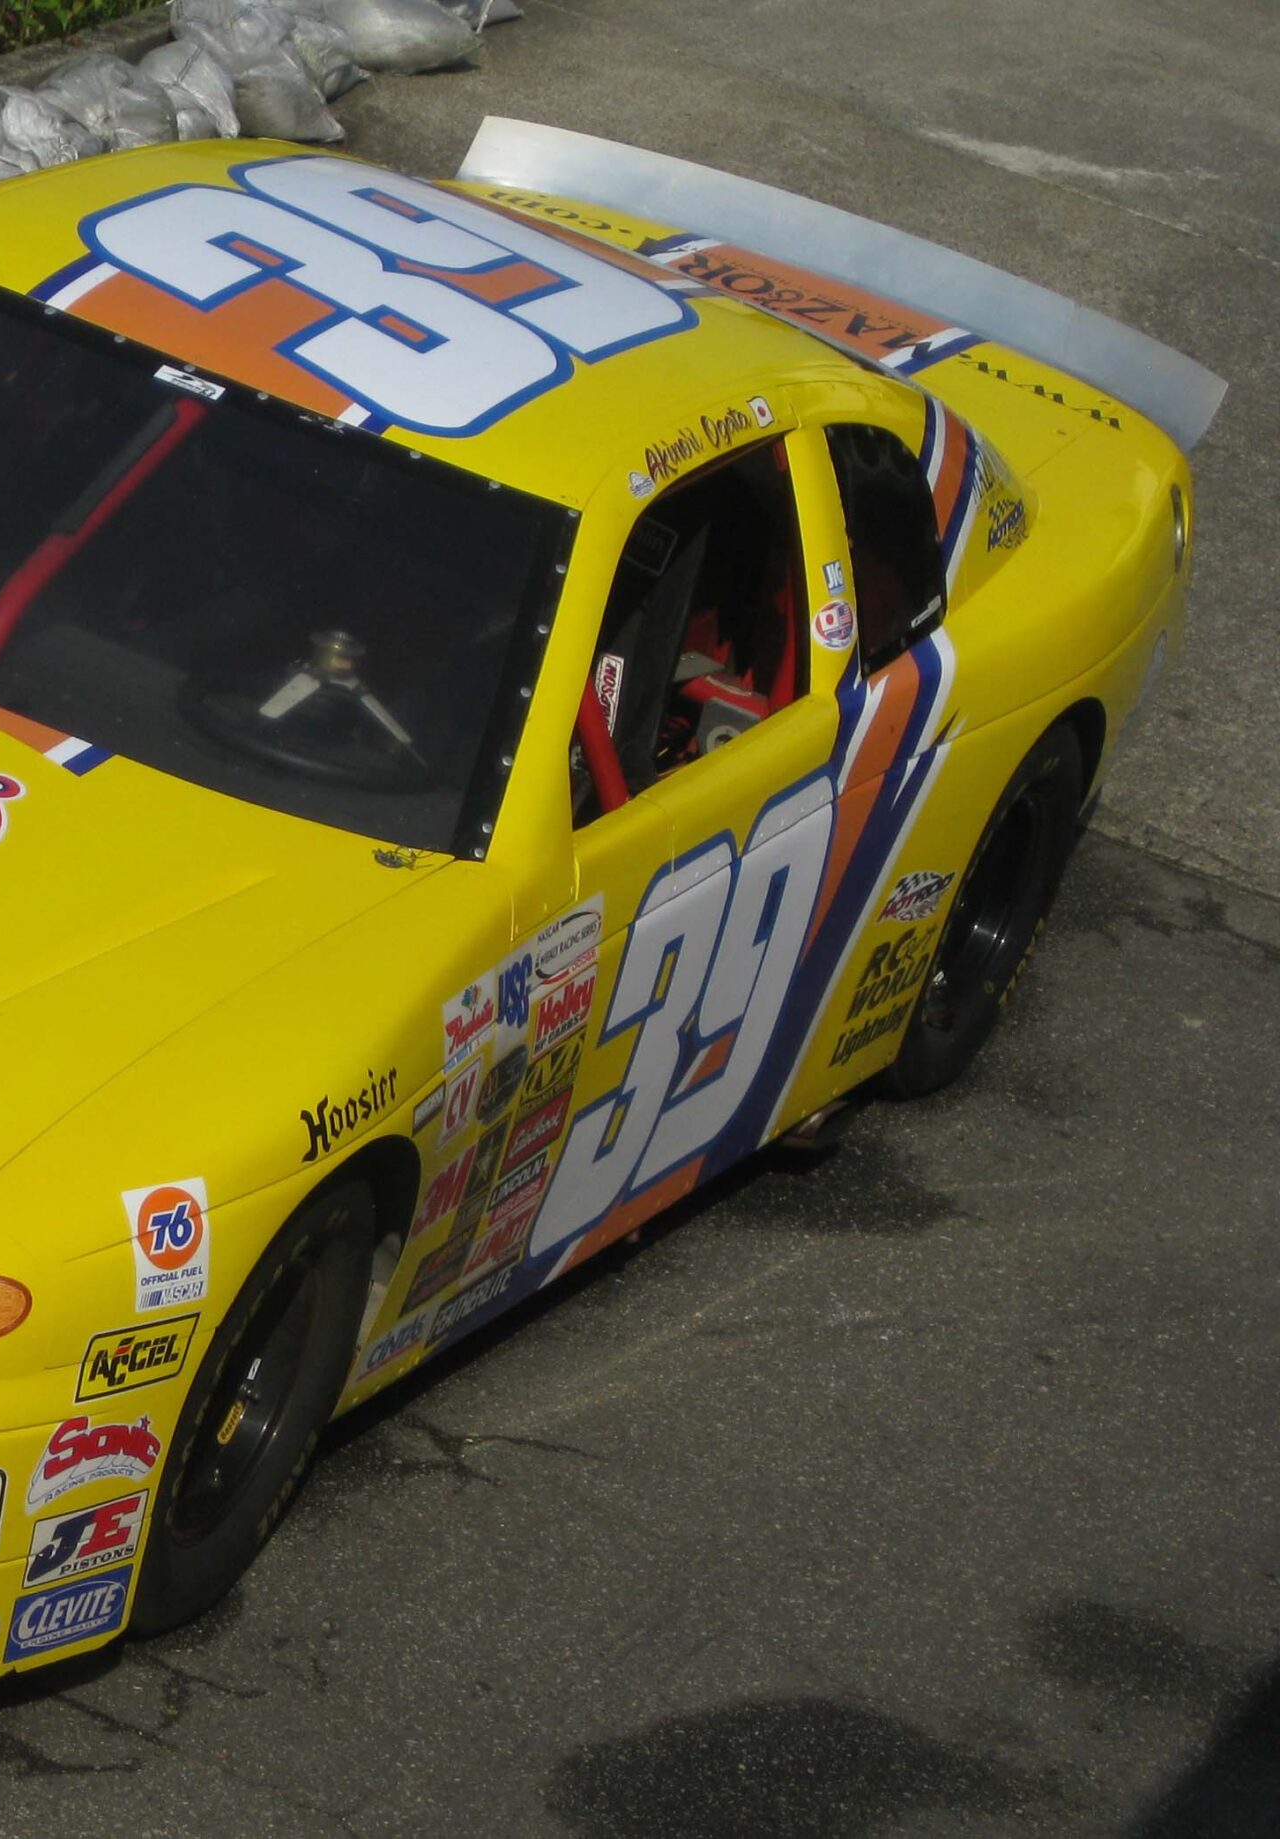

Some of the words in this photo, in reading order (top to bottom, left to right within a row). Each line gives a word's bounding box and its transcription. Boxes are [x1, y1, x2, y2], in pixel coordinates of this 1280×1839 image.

[77, 154, 700, 438] 39
[527, 768, 838, 1263] 39
[537, 975, 596, 1042] Holley
[300, 1067, 397, 1162] Hoosier
[146, 1201, 195, 1255] 76
[140, 1271, 179, 1287] OFFICIAL
[181, 1266, 204, 1282] FUEL
[88, 1333, 180, 1388] ACCEL
[43, 1477, 86, 1503] RACING
[89, 1468, 134, 1482] PRODUCTS
[27, 1496, 141, 1581] JE
[58, 1544, 134, 1576] PISTONS
[19, 1582, 121, 1640] CLEVITE
